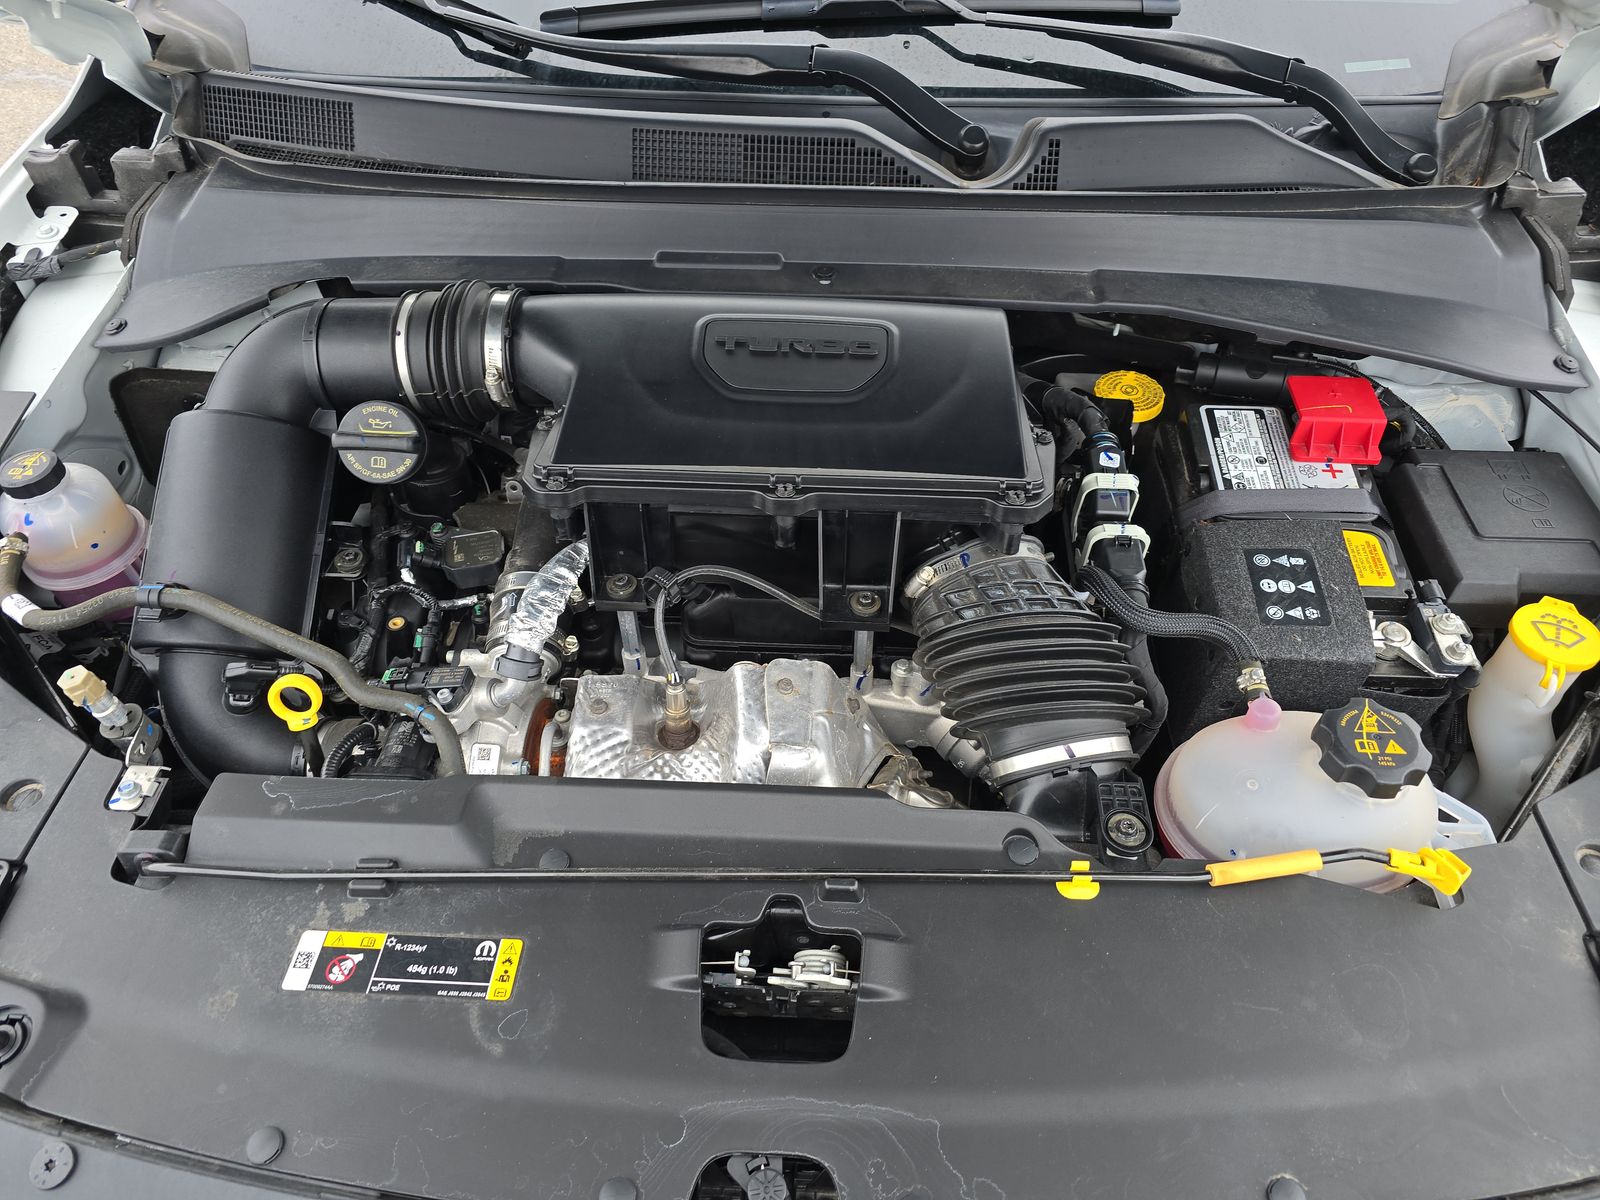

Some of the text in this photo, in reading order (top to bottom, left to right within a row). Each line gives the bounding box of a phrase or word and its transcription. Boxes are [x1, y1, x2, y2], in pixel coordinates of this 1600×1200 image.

[715, 335, 879, 356] TURBO
[362, 405, 399, 417] ENGINE OIL
[346, 453, 356, 464] API
[396, 458, 412, 475] 5W-30
[406, 964, 458, 977] 454g (1.0 lb)
